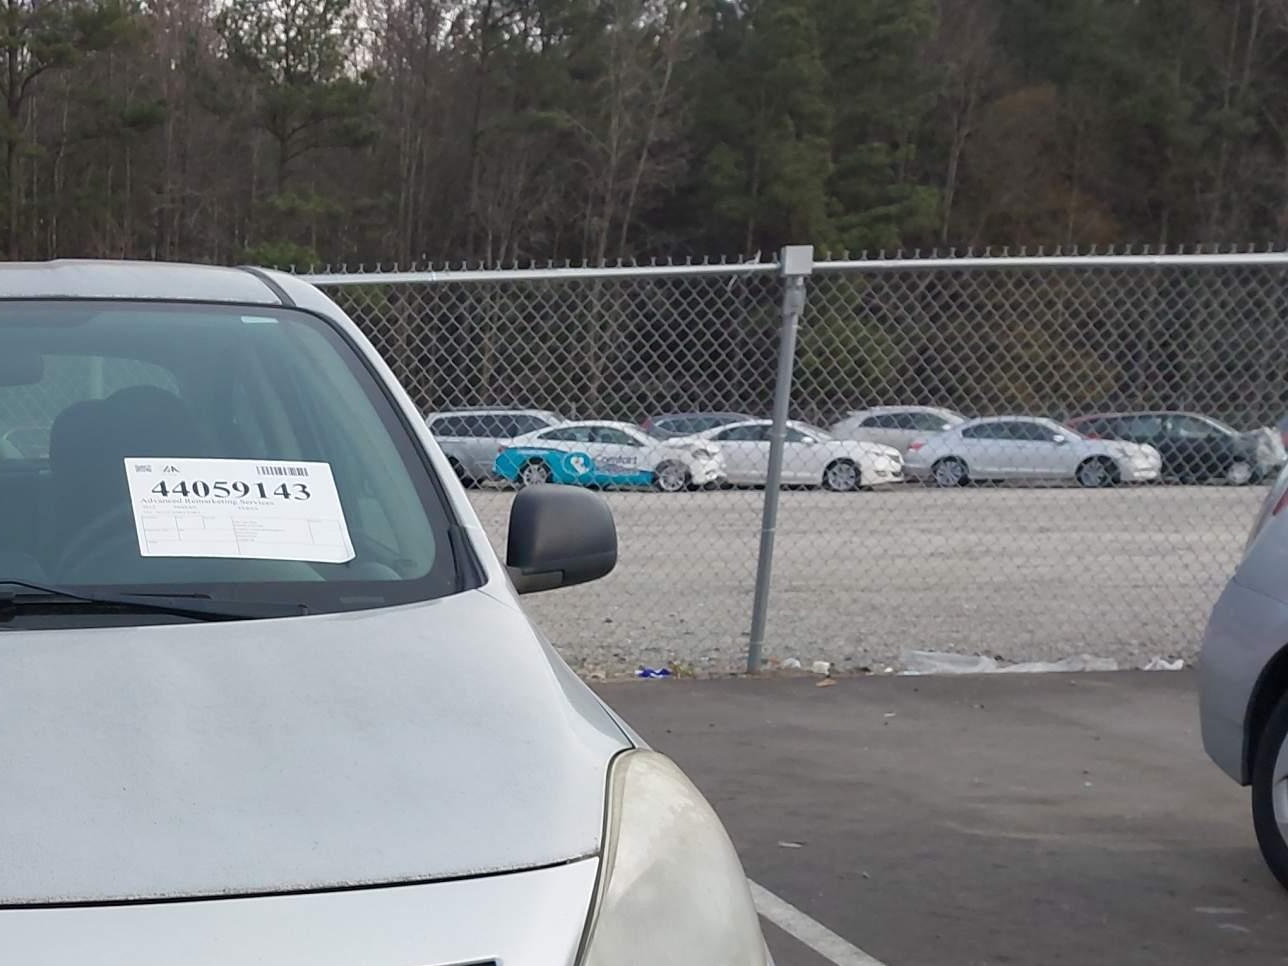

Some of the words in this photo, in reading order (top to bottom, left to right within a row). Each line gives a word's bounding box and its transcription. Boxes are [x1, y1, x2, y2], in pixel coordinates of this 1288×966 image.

[151, 480, 311, 500] 44059143
[184, 497, 238, 506] Remarketing
[240, 498, 275, 506] Services
